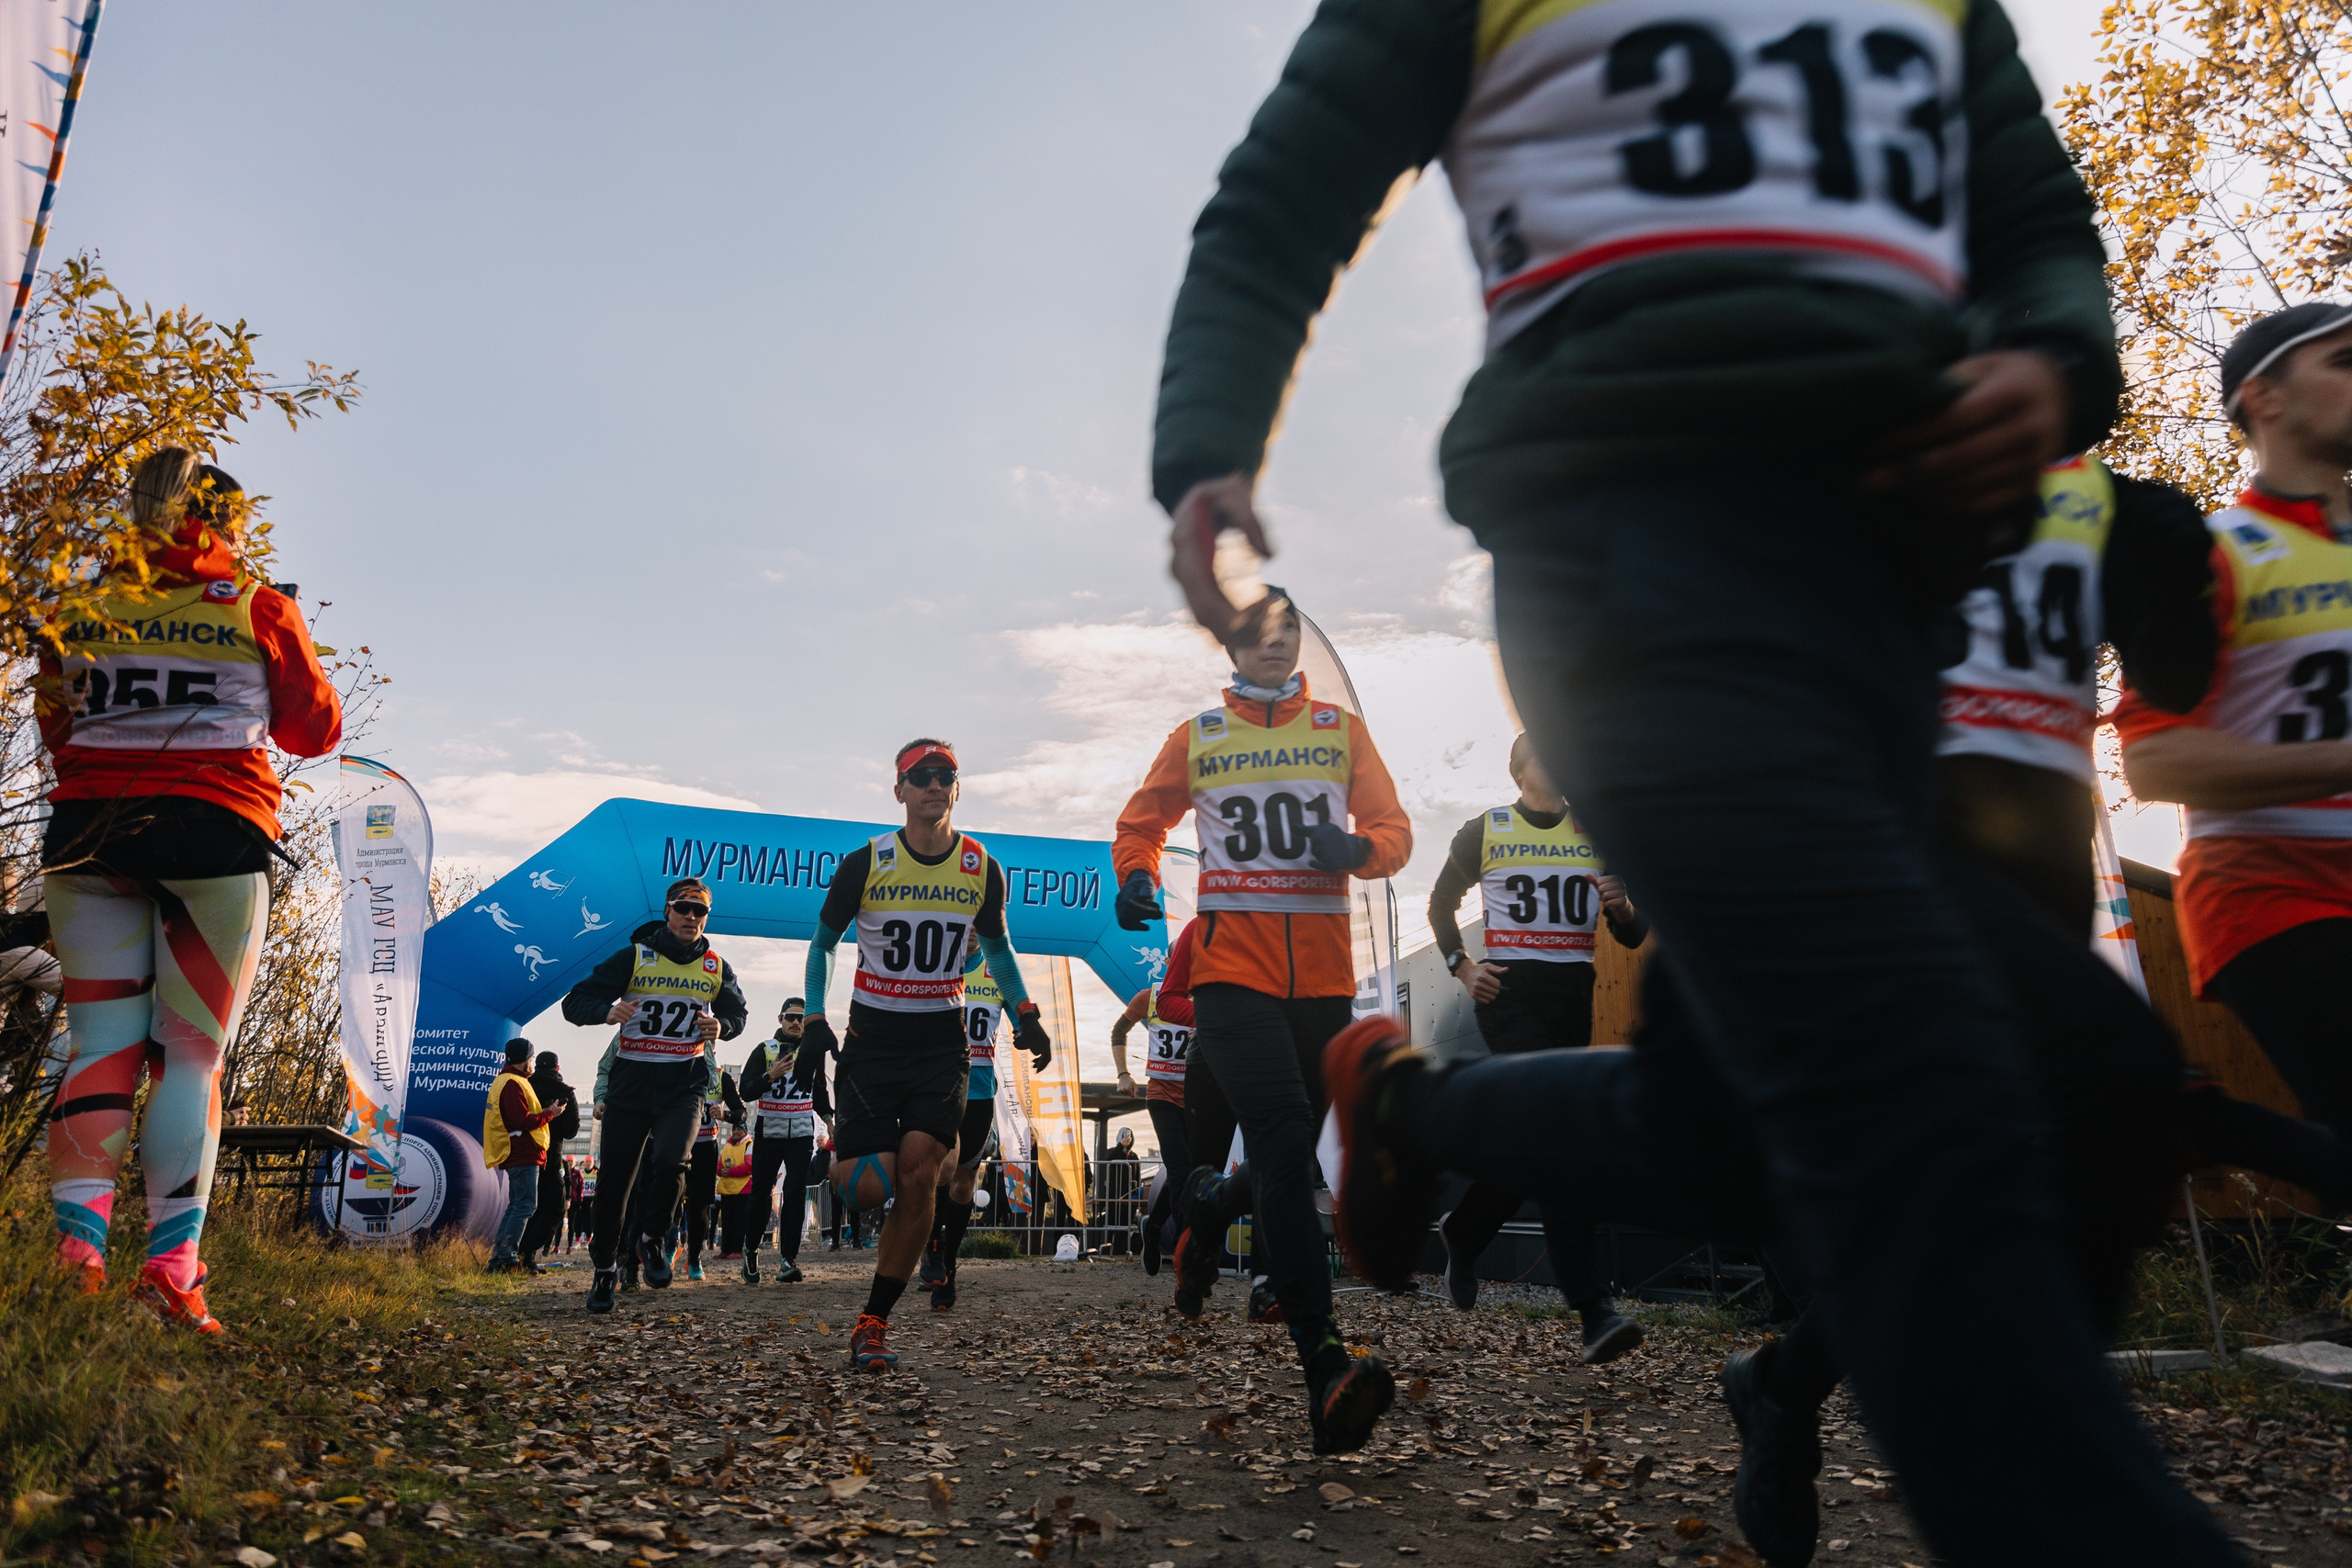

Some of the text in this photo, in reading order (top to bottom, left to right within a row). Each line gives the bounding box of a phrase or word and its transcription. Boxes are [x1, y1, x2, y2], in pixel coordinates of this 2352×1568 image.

[1604, 19, 1945, 230] 313
[1199, 747, 1344, 777] МУРМАНСК
[356, 847, 403, 857] Администрация
[375, 858, 407, 869] Мурманска
[662, 837, 1101, 910] МУРМАНС ГЕРОЙ
[369, 884, 395, 929] МАУ
[869, 885, 979, 906] МУРМАНСК
[1505, 874, 1590, 926] 310
[368, 937, 396, 974] ГСЦ
[882, 919, 967, 974] 307
[633, 976, 717, 995] МУРМАНСК
[413, 1029, 469, 1039] омитет
[639, 999, 703, 1038] 327
